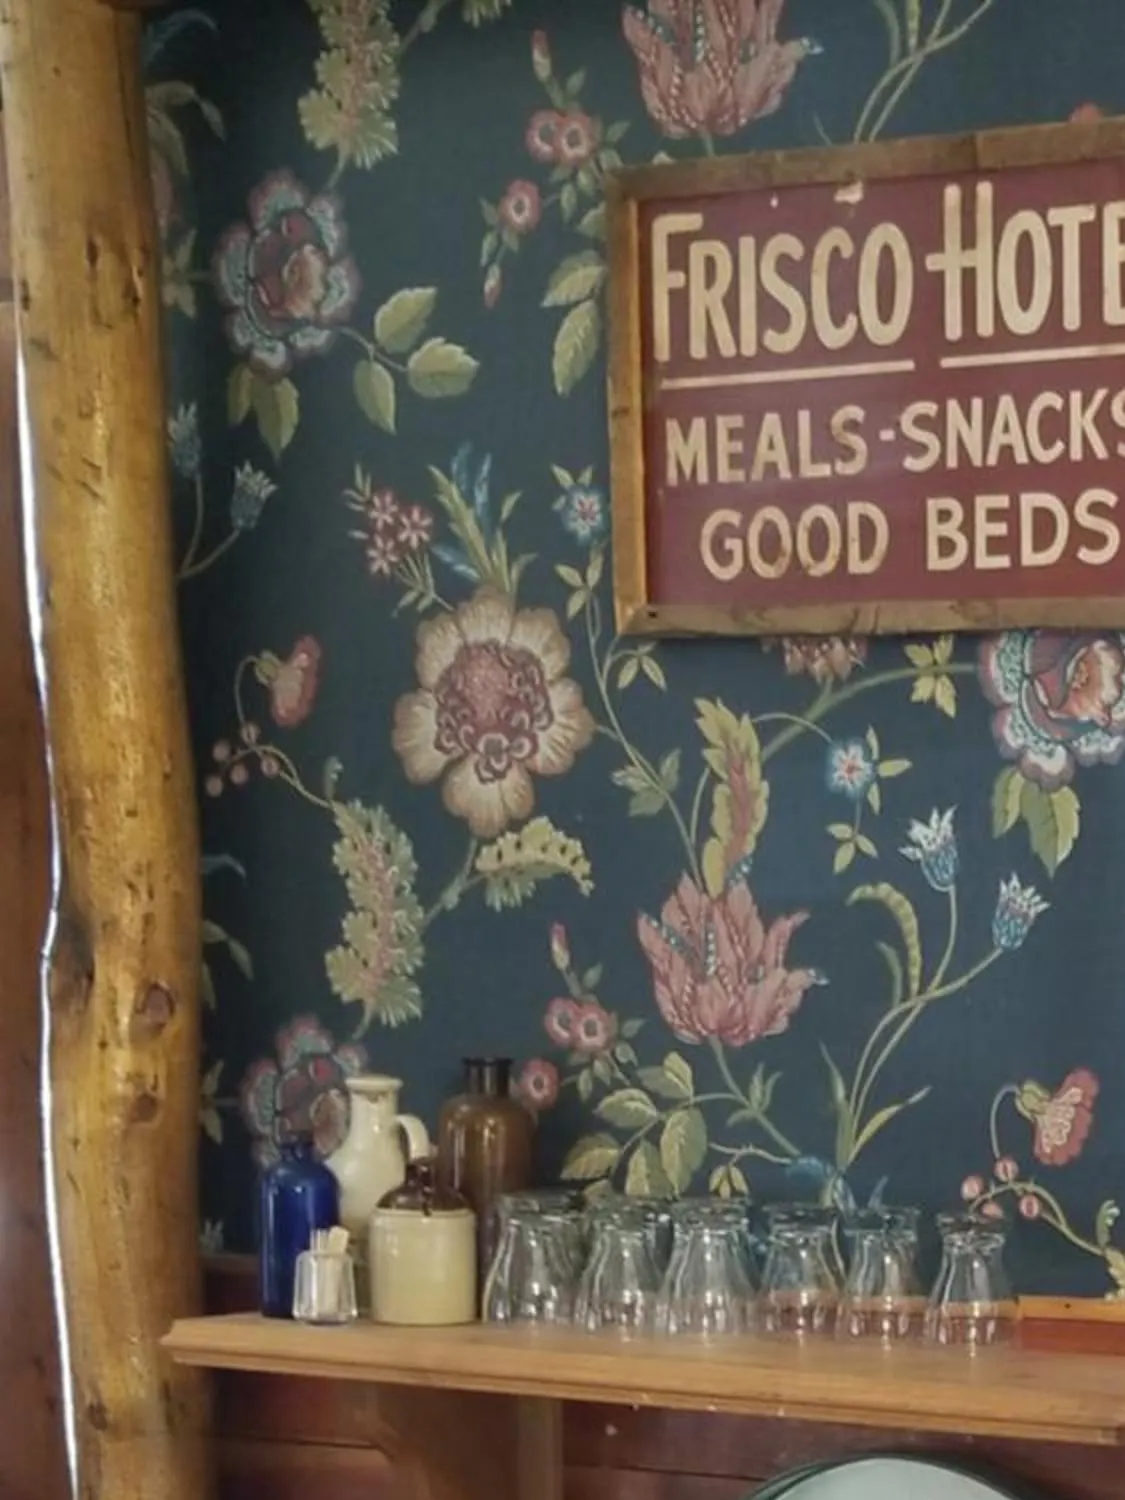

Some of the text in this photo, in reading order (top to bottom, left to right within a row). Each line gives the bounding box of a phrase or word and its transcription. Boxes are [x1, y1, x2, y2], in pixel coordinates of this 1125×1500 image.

[651, 212, 914, 362] FRISCO
[700, 488, 1121, 580] GOOD BEDS
